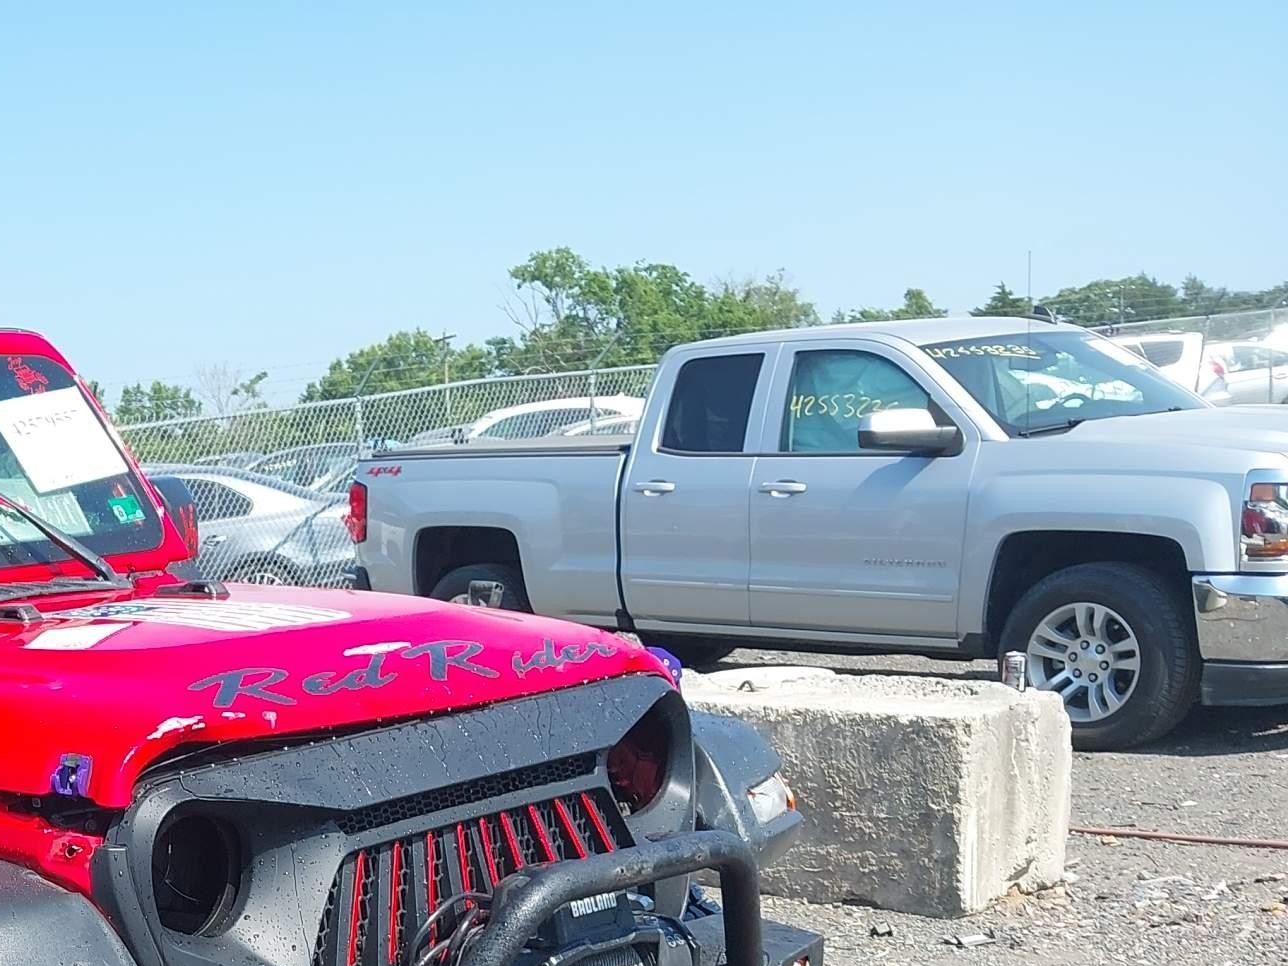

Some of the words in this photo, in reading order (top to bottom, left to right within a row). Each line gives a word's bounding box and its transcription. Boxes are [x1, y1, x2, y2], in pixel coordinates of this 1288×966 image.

[188, 652, 398, 706] Red
[401, 639, 616, 681] Rider
[570, 892, 617, 918] BADLAND
